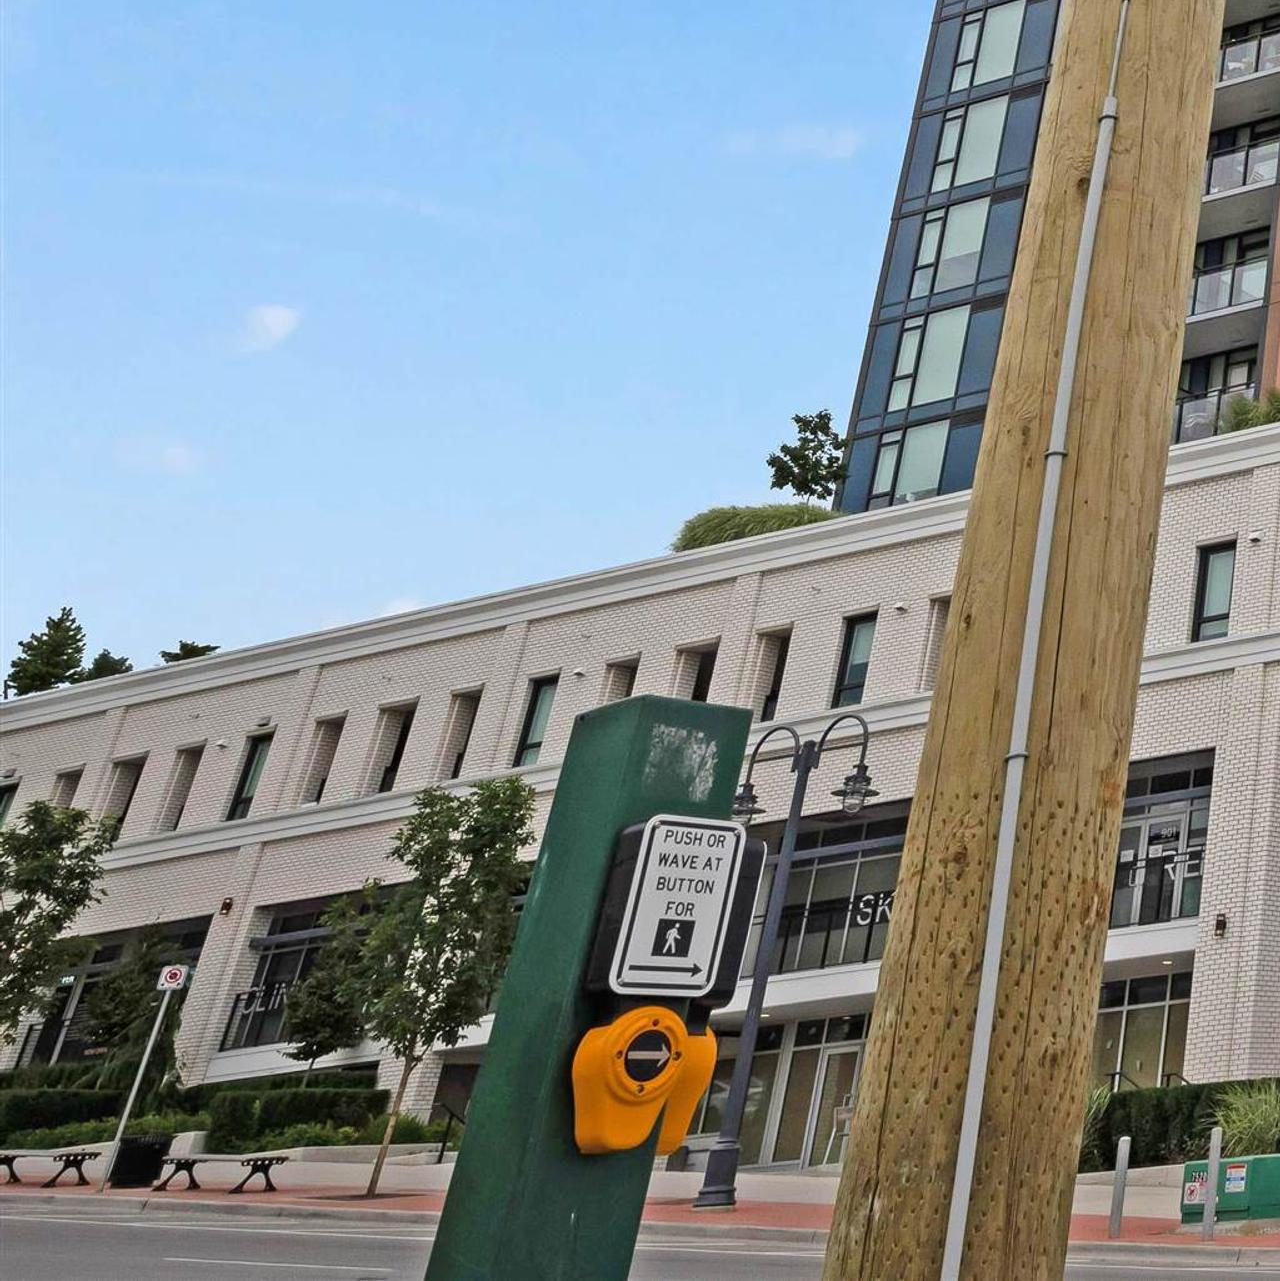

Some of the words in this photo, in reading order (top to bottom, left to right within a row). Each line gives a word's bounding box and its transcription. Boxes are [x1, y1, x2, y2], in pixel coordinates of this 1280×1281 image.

[664, 830, 703, 846] PUSH
[707, 834, 726, 848] OR
[659, 853, 698, 869] WAVE
[703, 857, 723, 871] AT
[656, 877, 715, 894] BUTTON
[665, 901, 695, 917] FOR
